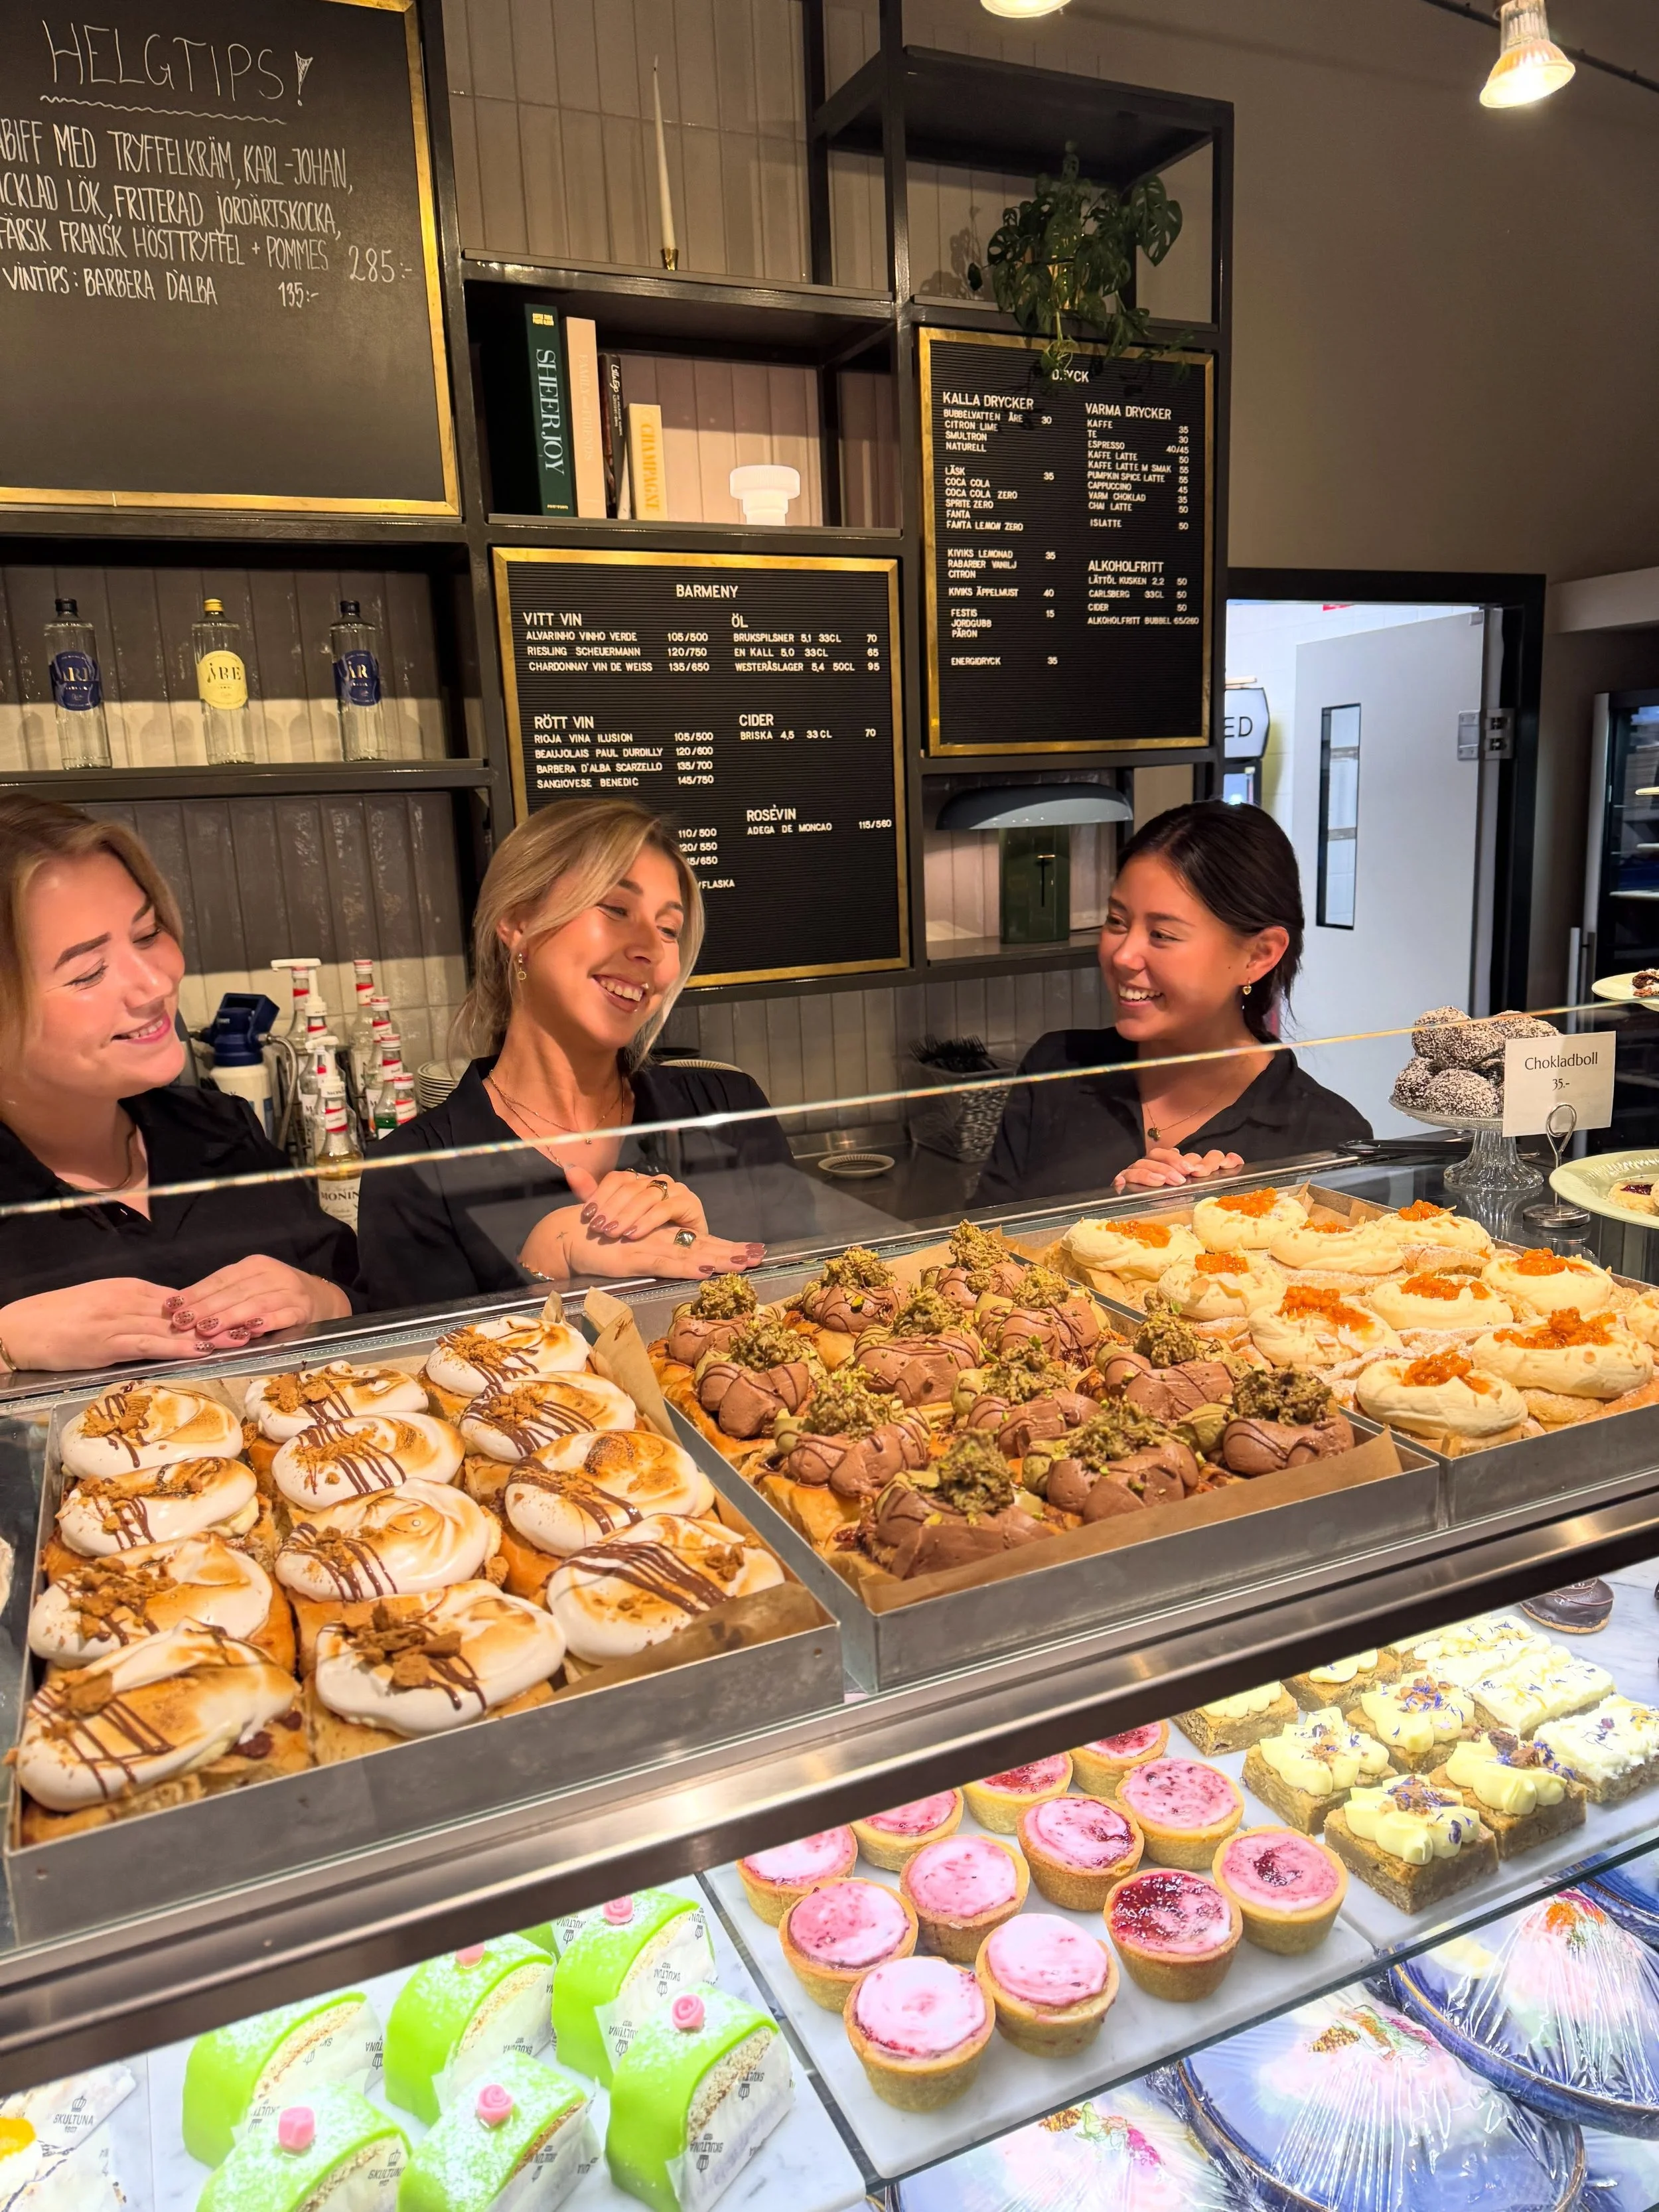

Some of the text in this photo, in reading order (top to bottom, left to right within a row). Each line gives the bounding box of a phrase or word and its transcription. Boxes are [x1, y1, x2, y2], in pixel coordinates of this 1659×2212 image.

[42, 20, 313, 106] HELGTIPS!
[53, 123, 96, 168] MED
[107, 130, 240, 190] TRYFFELKRÄM,
[67, 175, 113, 224] LÖK,
[114, 185, 203, 226] FRITERAD
[59, 220, 127, 258] FRANSK
[133, 225, 243, 264] HÖSTTRYFFEL
[266, 235, 328, 271] POMMES
[83, 267, 156, 301] BARBERA
[536, 349, 561, 429] SHEER
[942, 392, 1034, 410] KALLA DRYCKER
[944, 409, 1001, 421] BUBBELVATTEN
[1085, 403, 1171, 420] VARMA DRYCKER
[945, 420, 998, 431] CITRON LIME
[1087, 419, 1113, 429] KAFFE
[945, 431, 987, 441] SMULTRON
[1087, 429, 1097, 438] TE
[946, 442, 986, 452] NATURELL
[1088, 441, 1189, 454] ESPRESSO 40/45
[541, 431, 564, 475] JOY
[1088, 451, 1112, 459] KAFFE
[1116, 453, 1138, 461] LATTE
[640, 423, 660, 512] CHAMPAGNE
[945, 465, 1054, 480] LÄSK 35
[1088, 461, 1112, 470] KAFFE
[1116, 462, 1139, 471] LATTE
[1151, 465, 1171, 473] SMAK
[1088, 471, 1119, 480] PUMPKIN
[1143, 474, 1165, 482] LATTE
[970, 479, 990, 488] COLA
[1088, 482, 1131, 491] CAPPUCCINO
[945, 488, 966, 496] COCA
[970, 489, 991, 498] COLA
[1113, 493, 1146, 502] CHOKLAD
[946, 499, 971, 508] SPRITE
[946, 510, 970, 518] FANTA
[946, 520, 972, 529] FANTA
[1005, 522, 1023, 531] ZERO
[1090, 519, 1122, 528] ISLATTE
[948, 549, 974, 557] KIVIKS
[978, 550, 1013, 558] LEMONAD
[948, 559, 986, 569] RABARBER
[1088, 560, 1164, 573] ALKOHOLFRITT
[948, 570, 976, 579] CITRON
[676, 584, 739, 599] BARMENY
[948, 587, 973, 596] KIVIKS
[1088, 589, 1130, 598] CARLSBERG
[951, 609, 977, 617] FESTIS
[1088, 603, 1109, 612] CIDER
[523, 612, 582, 627] VITT VIN
[731, 613, 749, 628] ÖL
[951, 619, 992, 628] JORDGUBB
[526, 631, 708, 642] ALVARINHO VINHO VERDE 105/500
[733, 633, 794, 642] BRUKSPILSNER
[818, 634, 841, 643] 33CL
[867, 634, 877, 643] 70
[528, 646, 707, 657] RIESLING SCHEUERMANN 120/750
[734, 648, 879, 657] EN KALL 33CL 65
[735, 660, 804, 672] WESTERÅSLAGER
[867, 662, 880, 671] 95
[951, 656, 1058, 666] ENERGIDRYCK 35
[529, 662, 709, 672] CHARDONNAY VIN DE WEISS 135/650
[534, 713, 594, 729] RÖTT VIN
[739, 713, 774, 727] CIDER
[534, 732, 713, 743] RIOJA VINA ILUSION 105/500
[740, 731, 773, 741] BRISKA
[865, 729, 876, 737] 70
[535, 747, 713, 759] BEAUJOLAIS PAUL DURDILLY 120/600
[536, 765, 576, 774] BARBERA
[616, 763, 663, 772] SCARZELLO
[677, 761, 713, 771] 135/700
[537, 775, 714, 788] SANGIOVESE BENEDIC 145/750
[747, 820, 892, 835] ADEGA DE MONCAO 115/560
[1525, 1051, 1598, 1070] Chokladboll
[321, 1191, 360, 1201] MONIN
[52, 2114, 94, 2125] SKULTUNA
